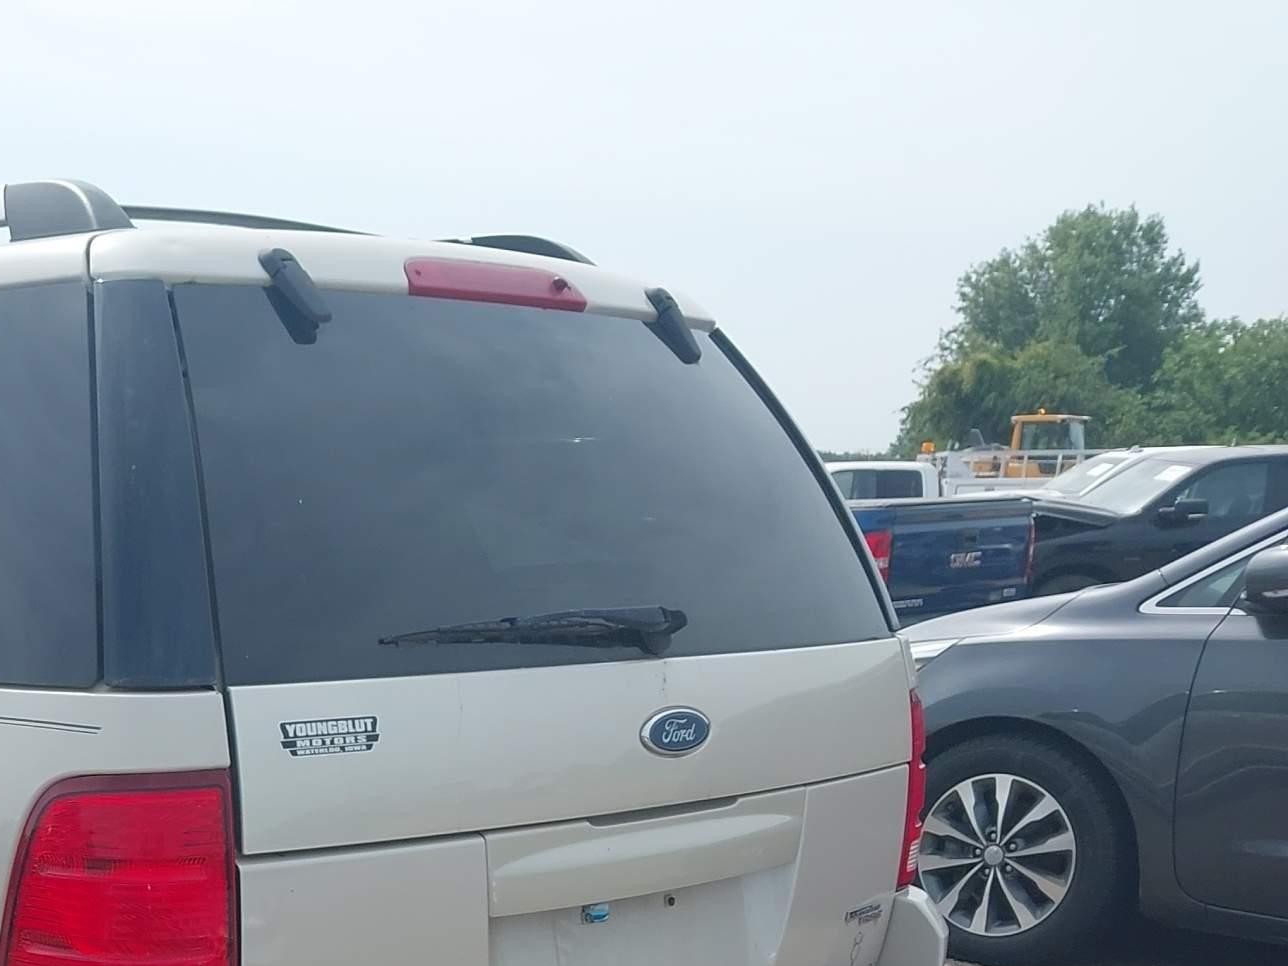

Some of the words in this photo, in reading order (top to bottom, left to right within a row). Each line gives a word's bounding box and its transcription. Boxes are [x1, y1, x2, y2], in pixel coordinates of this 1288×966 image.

[285, 718, 374, 738] YOUNGBLUT
[662, 718, 696, 743] Ford
[295, 735, 368, 748] MOTORS
